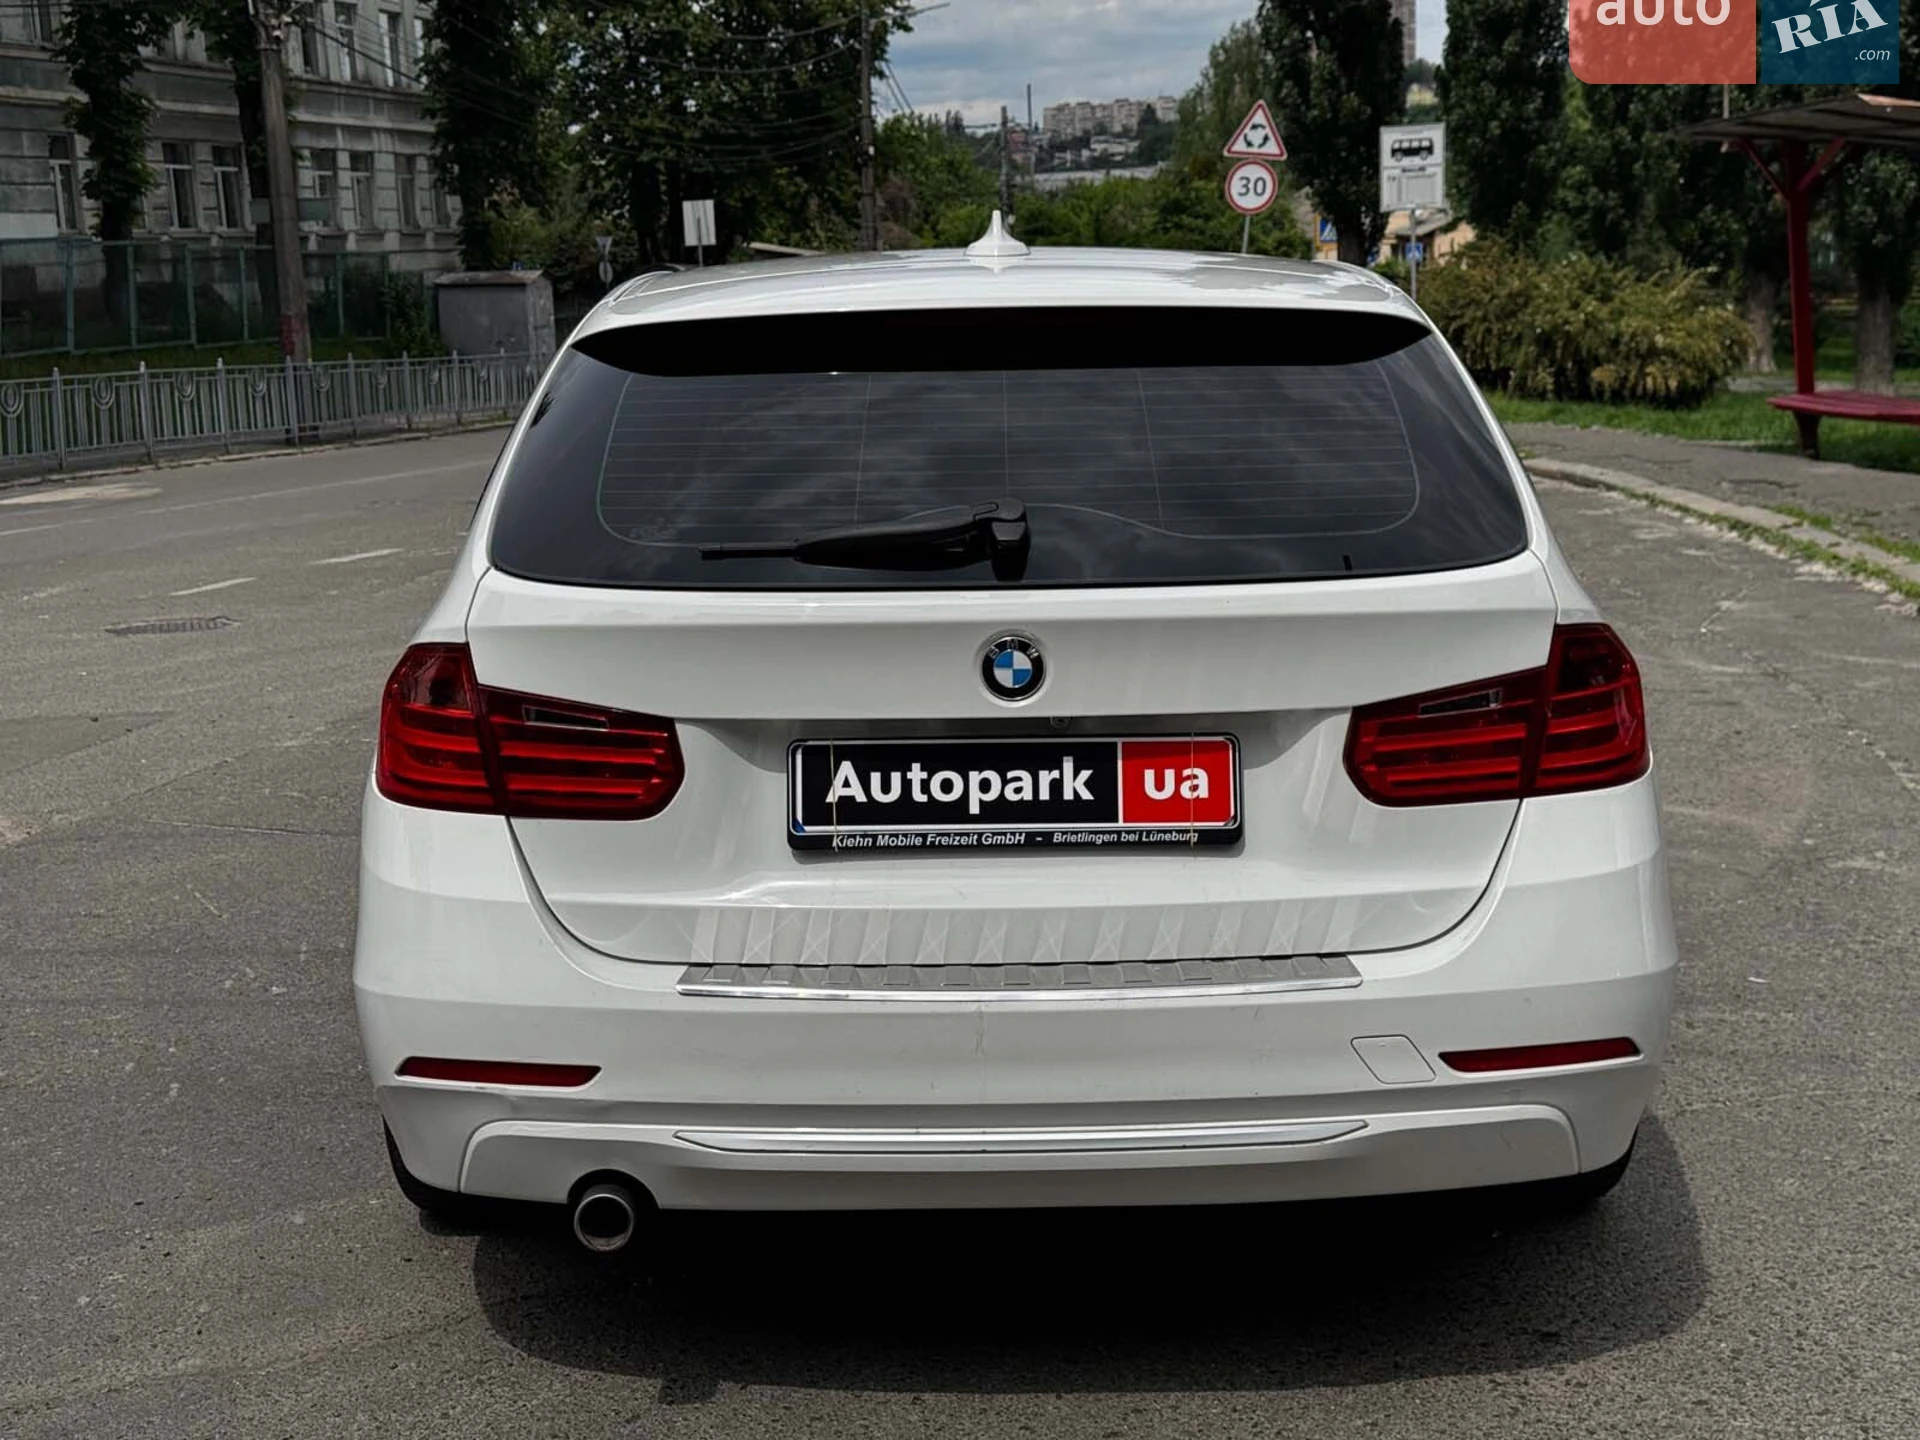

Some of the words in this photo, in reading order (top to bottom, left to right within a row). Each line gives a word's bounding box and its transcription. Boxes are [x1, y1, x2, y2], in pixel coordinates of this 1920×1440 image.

[1237, 176, 1267, 197] 30
[987, 639, 1039, 660] BMW
[825, 756, 1095, 815] Autopark
[1143, 766, 1209, 801] ua
[832, 833, 873, 848] Kiehn
[876, 833, 923, 847] Mobile
[926, 832, 978, 846] Freizeit
[981, 832, 1026, 845] GmbH
[1053, 832, 1118, 844] Brietlingen
[1121, 831, 1139, 842] bei
[1142, 830, 1199, 843] Lüneburg
